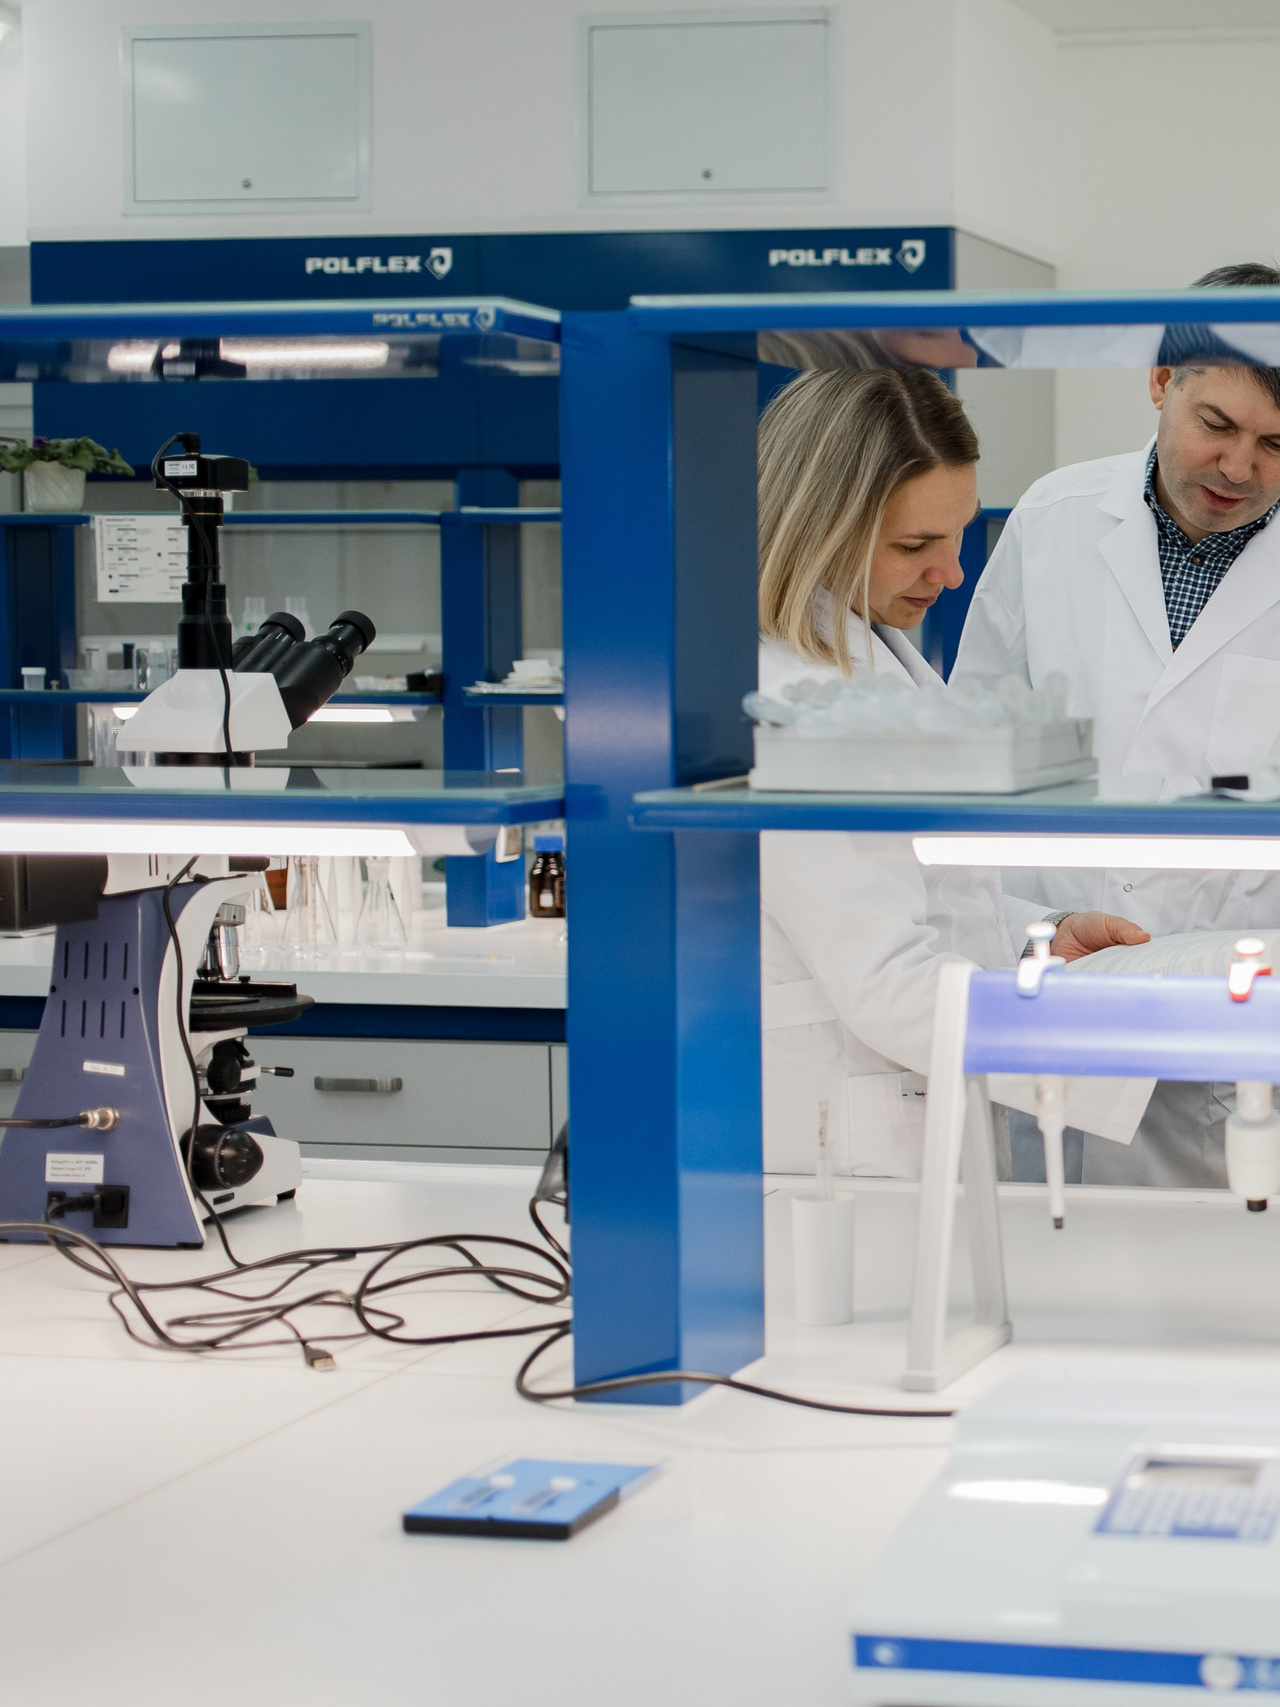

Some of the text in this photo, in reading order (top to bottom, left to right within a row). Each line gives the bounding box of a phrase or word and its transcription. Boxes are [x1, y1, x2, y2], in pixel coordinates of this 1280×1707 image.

[305, 256, 422, 274] POLFLEX
[768, 248, 892, 267] POLFLEX
[372, 312, 471, 327] POLFLEX
